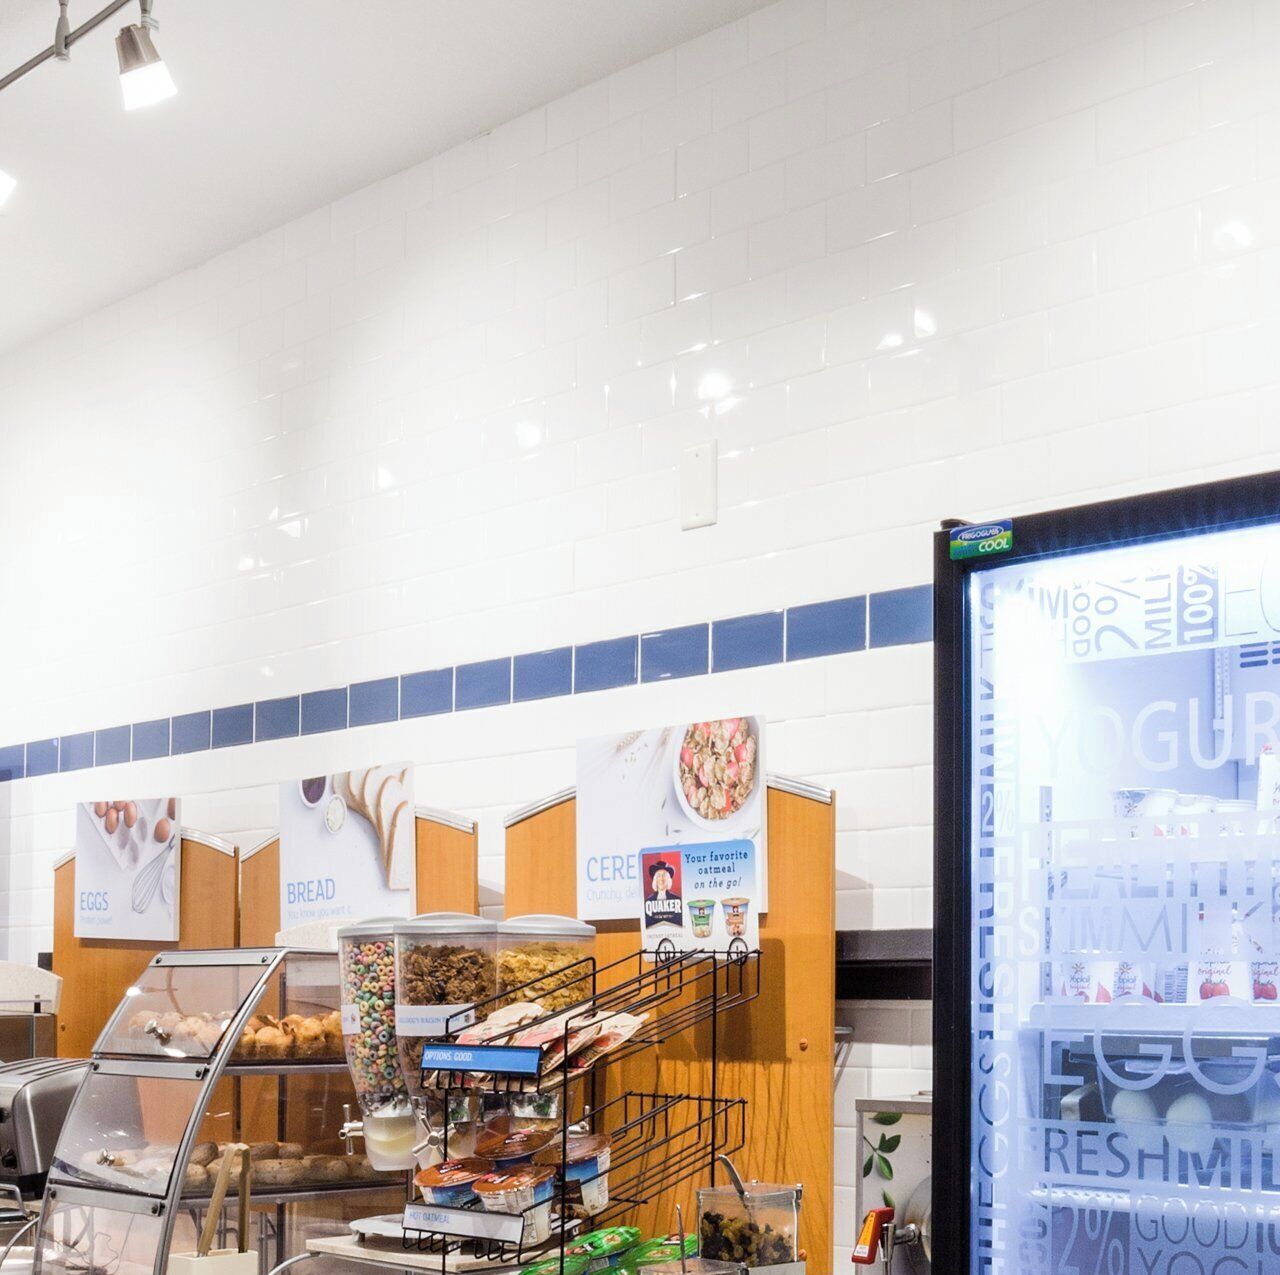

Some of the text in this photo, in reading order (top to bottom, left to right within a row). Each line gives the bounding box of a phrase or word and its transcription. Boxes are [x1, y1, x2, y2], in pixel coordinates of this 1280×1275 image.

[978, 539, 1010, 552] COOL
[685, 850, 748, 863] Your favorite
[586, 854, 637, 882] CERE
[698, 862, 735, 875] oatmeal
[287, 878, 336, 904] BREAD
[694, 876, 742, 890] on the go!
[80, 891, 109, 911] EGGS
[645, 899, 682, 917] QUAKER
